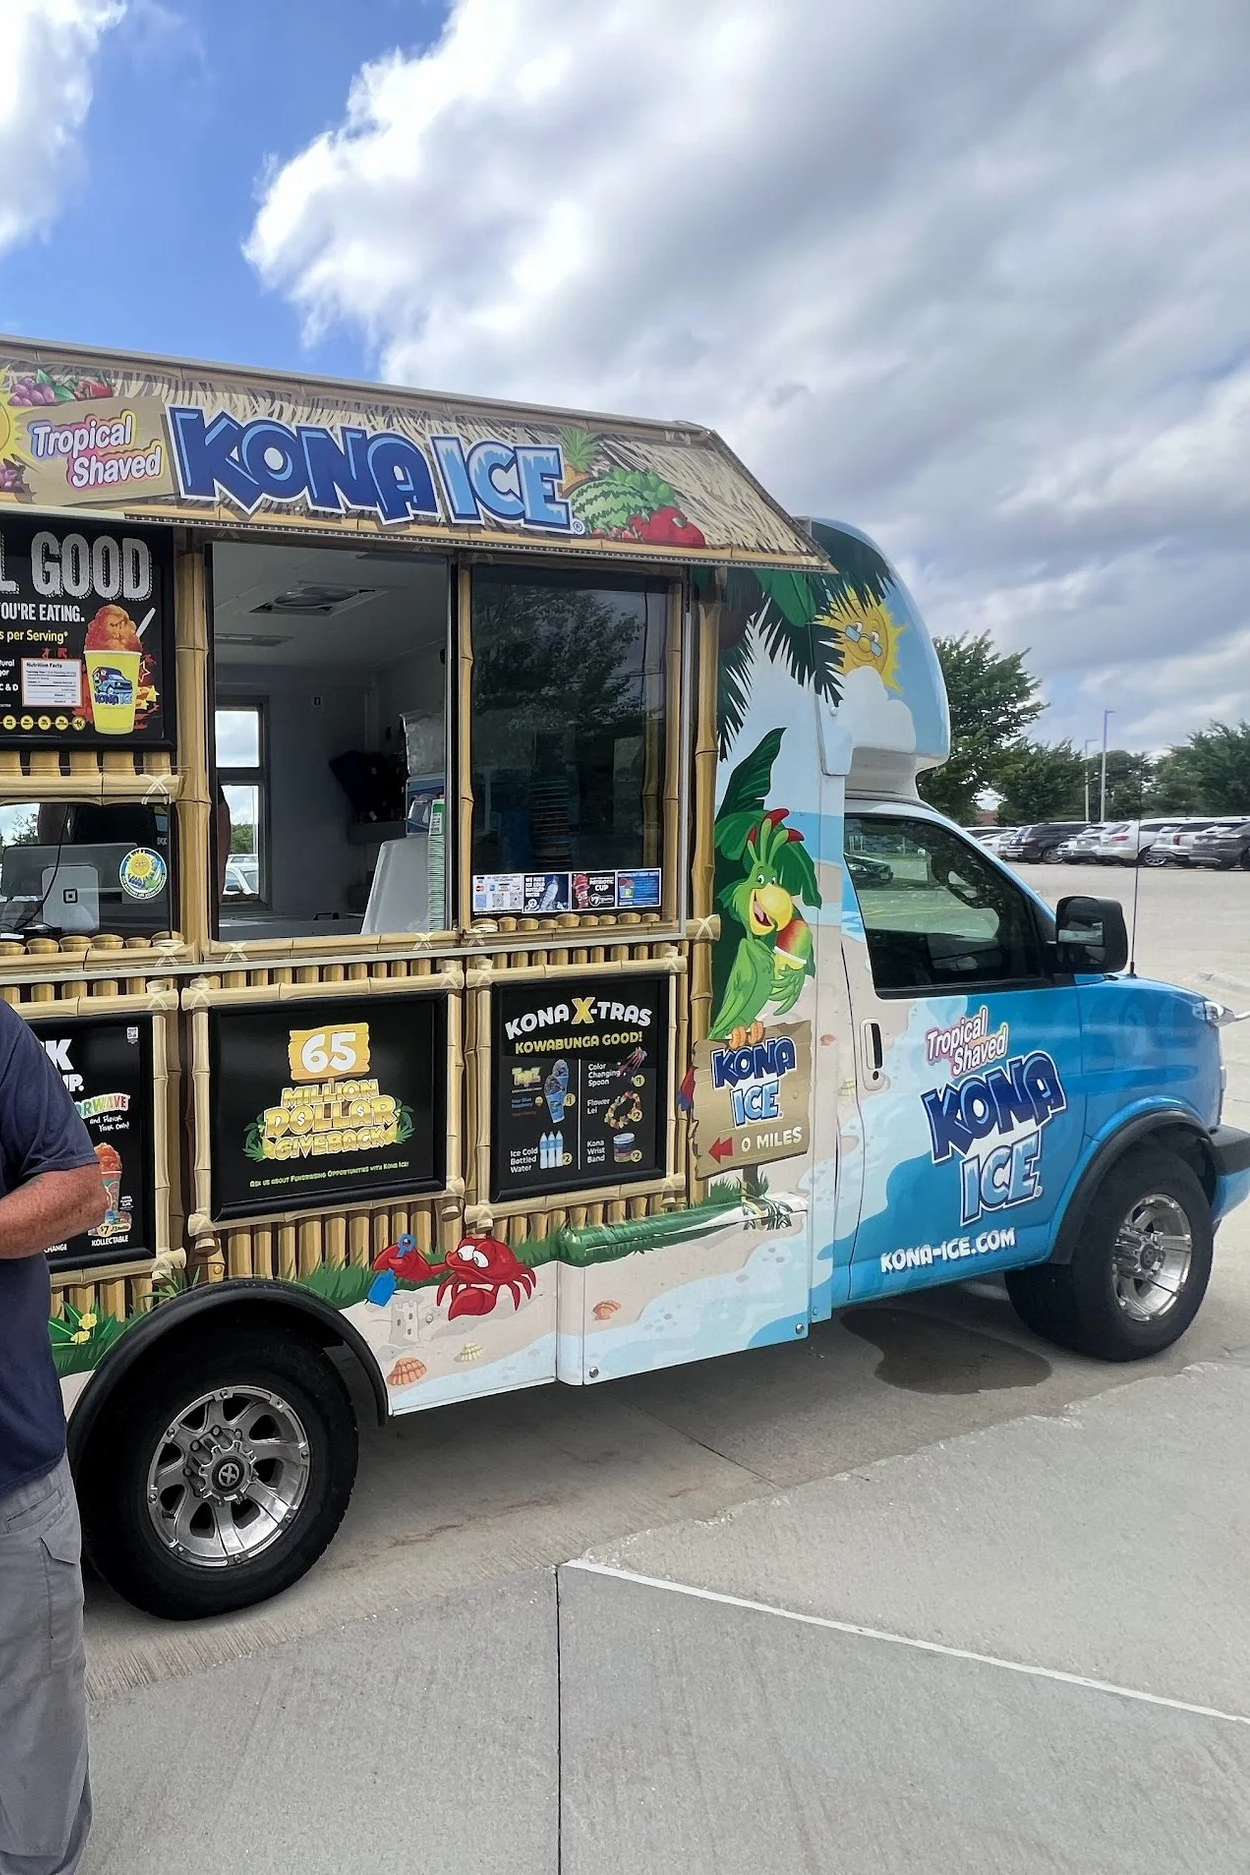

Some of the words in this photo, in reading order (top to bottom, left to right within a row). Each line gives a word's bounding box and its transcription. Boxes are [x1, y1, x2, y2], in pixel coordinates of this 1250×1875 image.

[32, 414, 132, 459] Tropical
[71, 445, 162, 488] Shaved
[167, 404, 441, 525] KONA
[31, 531, 153, 601] GOOD
[39, 604, 85, 623] EATING.
[7, 631, 24, 643] per
[5, 683, 12, 691] &
[505, 1003, 569, 1040] KONA
[571, 997, 652, 1027] X-TRAS
[515, 1035, 600, 1055] KOWABUNGA
[602, 1031, 643, 1046] GOOD!
[927, 1008, 988, 1063] Tropical
[39, 1038, 74, 1071] K
[301, 1031, 357, 1073] 65
[588, 1063, 606, 1071] Color
[711, 1035, 797, 1089] KONA
[952, 1027, 1008, 1076] Shaved
[588, 1070, 620, 1078] Changing
[588, 1079, 610, 1088] Spoon
[281, 1079, 379, 1108] MILLION
[587, 1098, 610, 1106] Flower
[731, 1080, 781, 1128] ICE
[921, 1050, 1067, 1165] KONA
[264, 1094, 400, 1138] DOLLAR
[587, 1106, 598, 1115] Lei
[274, 1126, 387, 1160] GIVEBACK
[522, 1147, 538, 1156] Cold
[741, 1136, 751, 1152] 0
[756, 1127, 802, 1148] MILES
[510, 1155, 536, 1166] Bottled
[510, 1165, 532, 1173] Water
[587, 1154, 605, 1163] Band
[960, 1129, 1042, 1227] ICE
[91, 1235, 129, 1246] KOLLECTABLE
[880, 1226, 1016, 1273] KONA-ICE.COM
